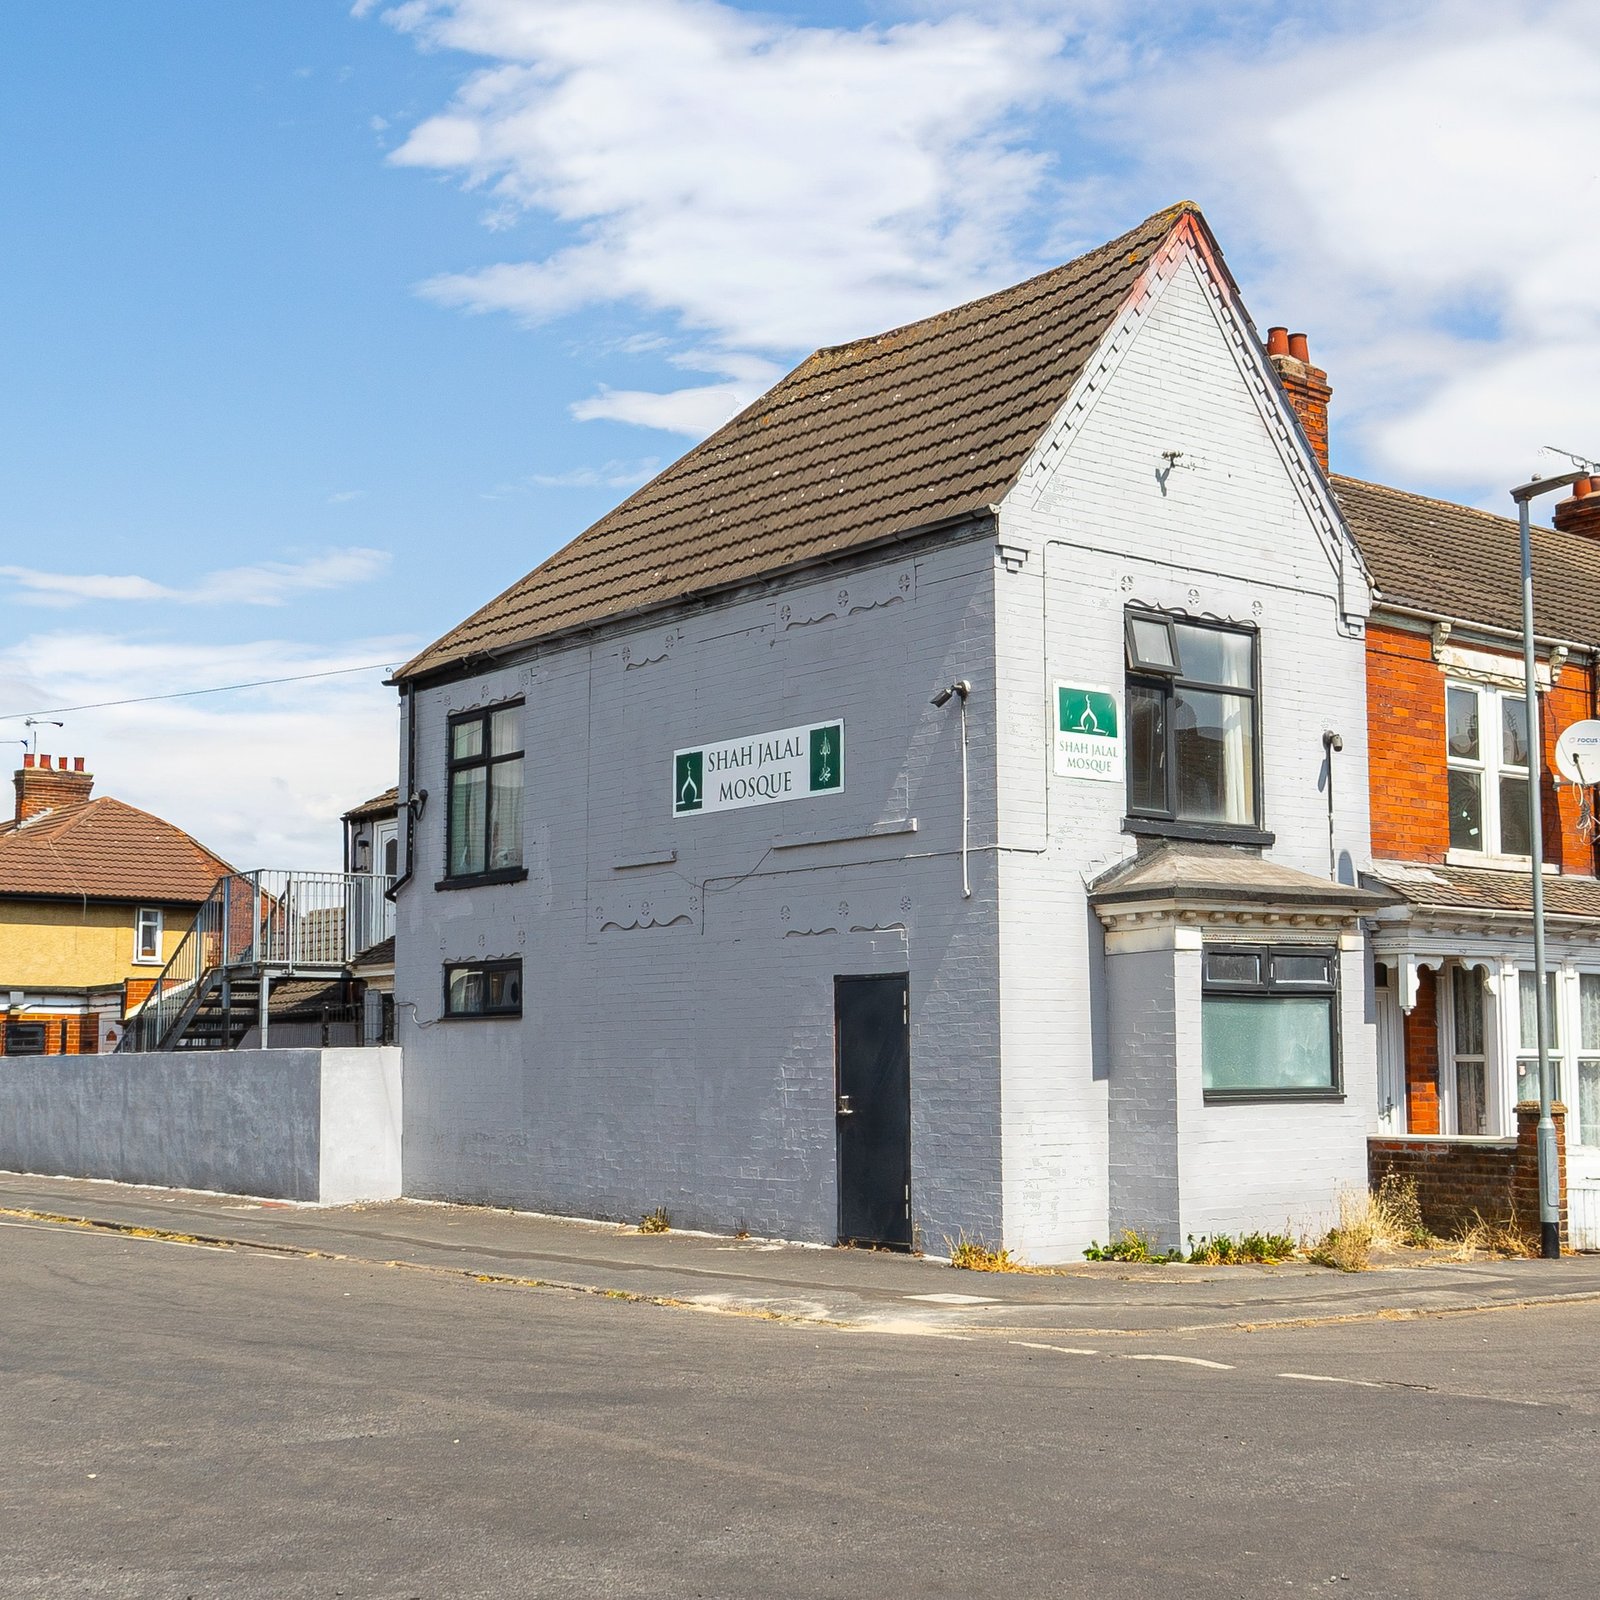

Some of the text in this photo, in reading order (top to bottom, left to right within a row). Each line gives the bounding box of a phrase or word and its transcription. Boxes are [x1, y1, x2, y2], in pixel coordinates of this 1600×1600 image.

[708, 744, 752, 772] SHAH
[757, 736, 803, 769] JALAL
[1059, 740, 1118, 758] SHAH JALAL
[1067, 757, 1112, 774] MOSQUE
[719, 771, 792, 802] MOSQUE
